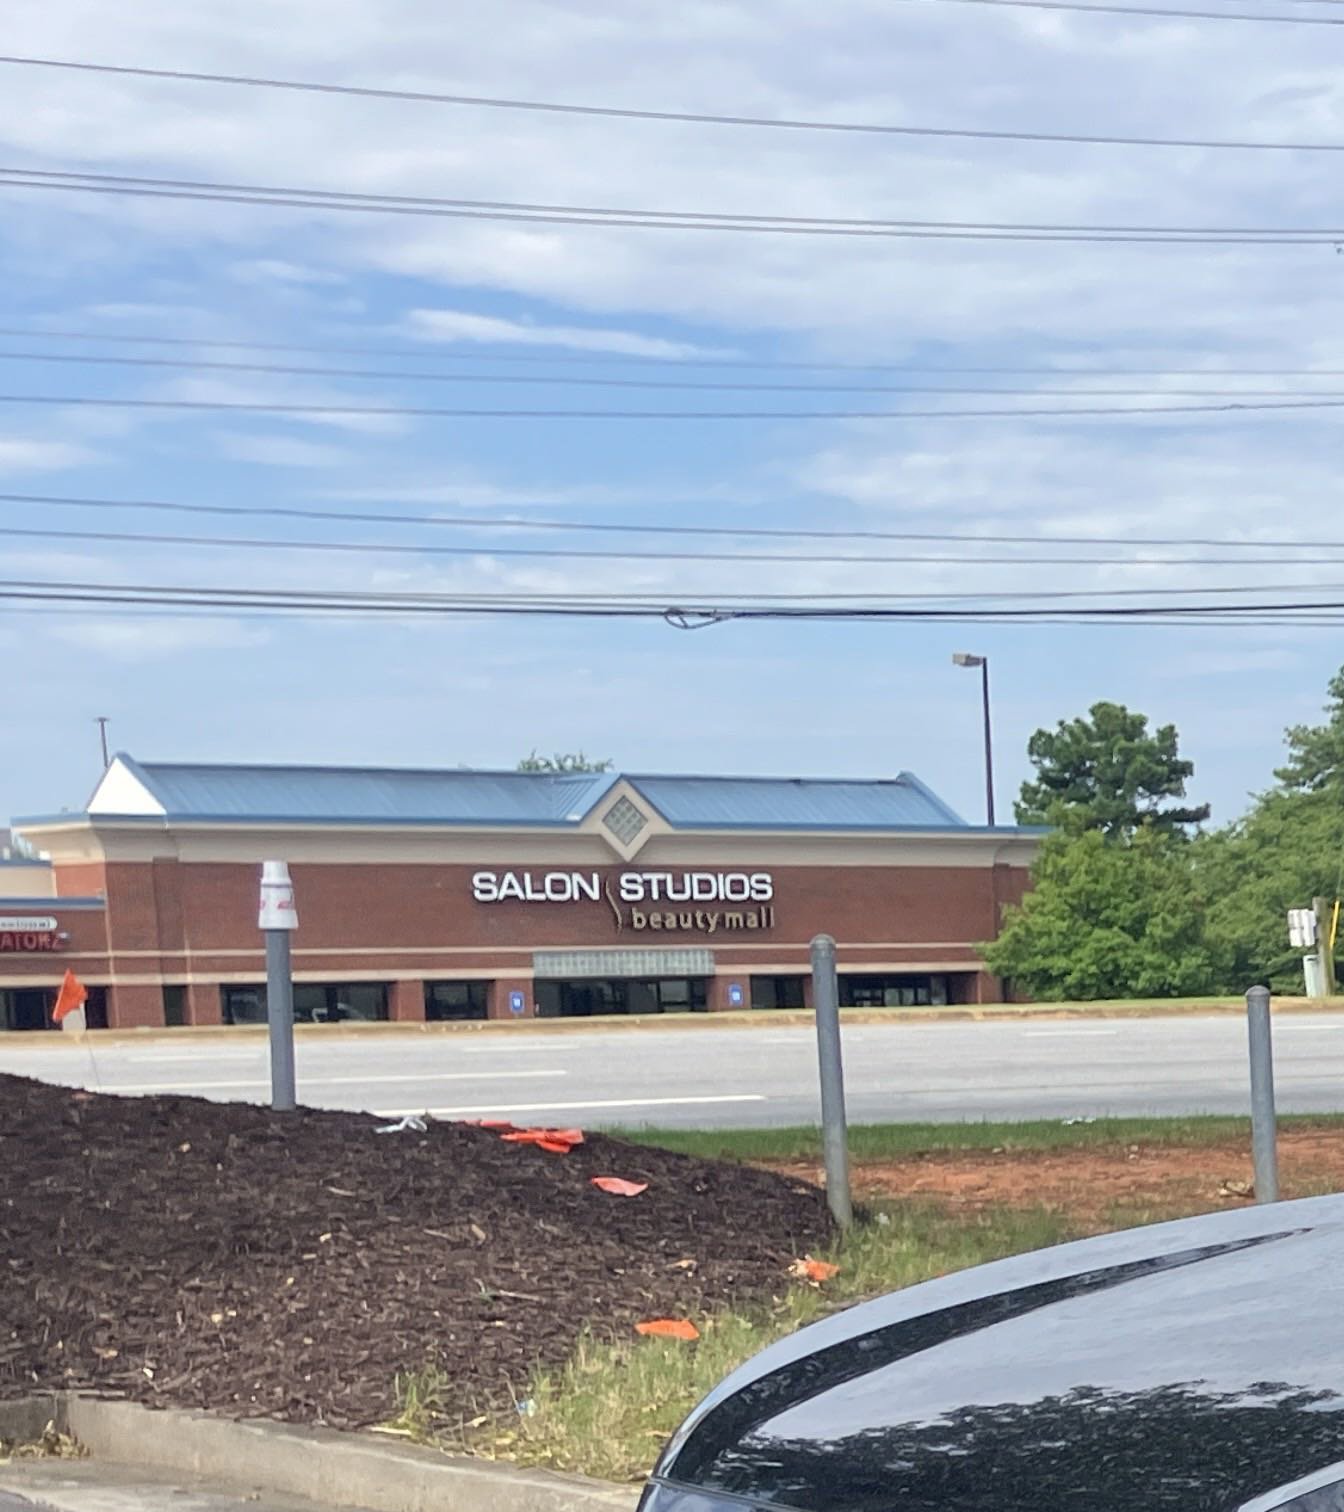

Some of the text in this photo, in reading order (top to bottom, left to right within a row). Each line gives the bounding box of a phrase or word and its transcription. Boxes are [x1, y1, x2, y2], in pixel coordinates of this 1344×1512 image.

[472, 872, 773, 901] SALON STUDIOS
[632, 906, 775, 932] beauty mall
